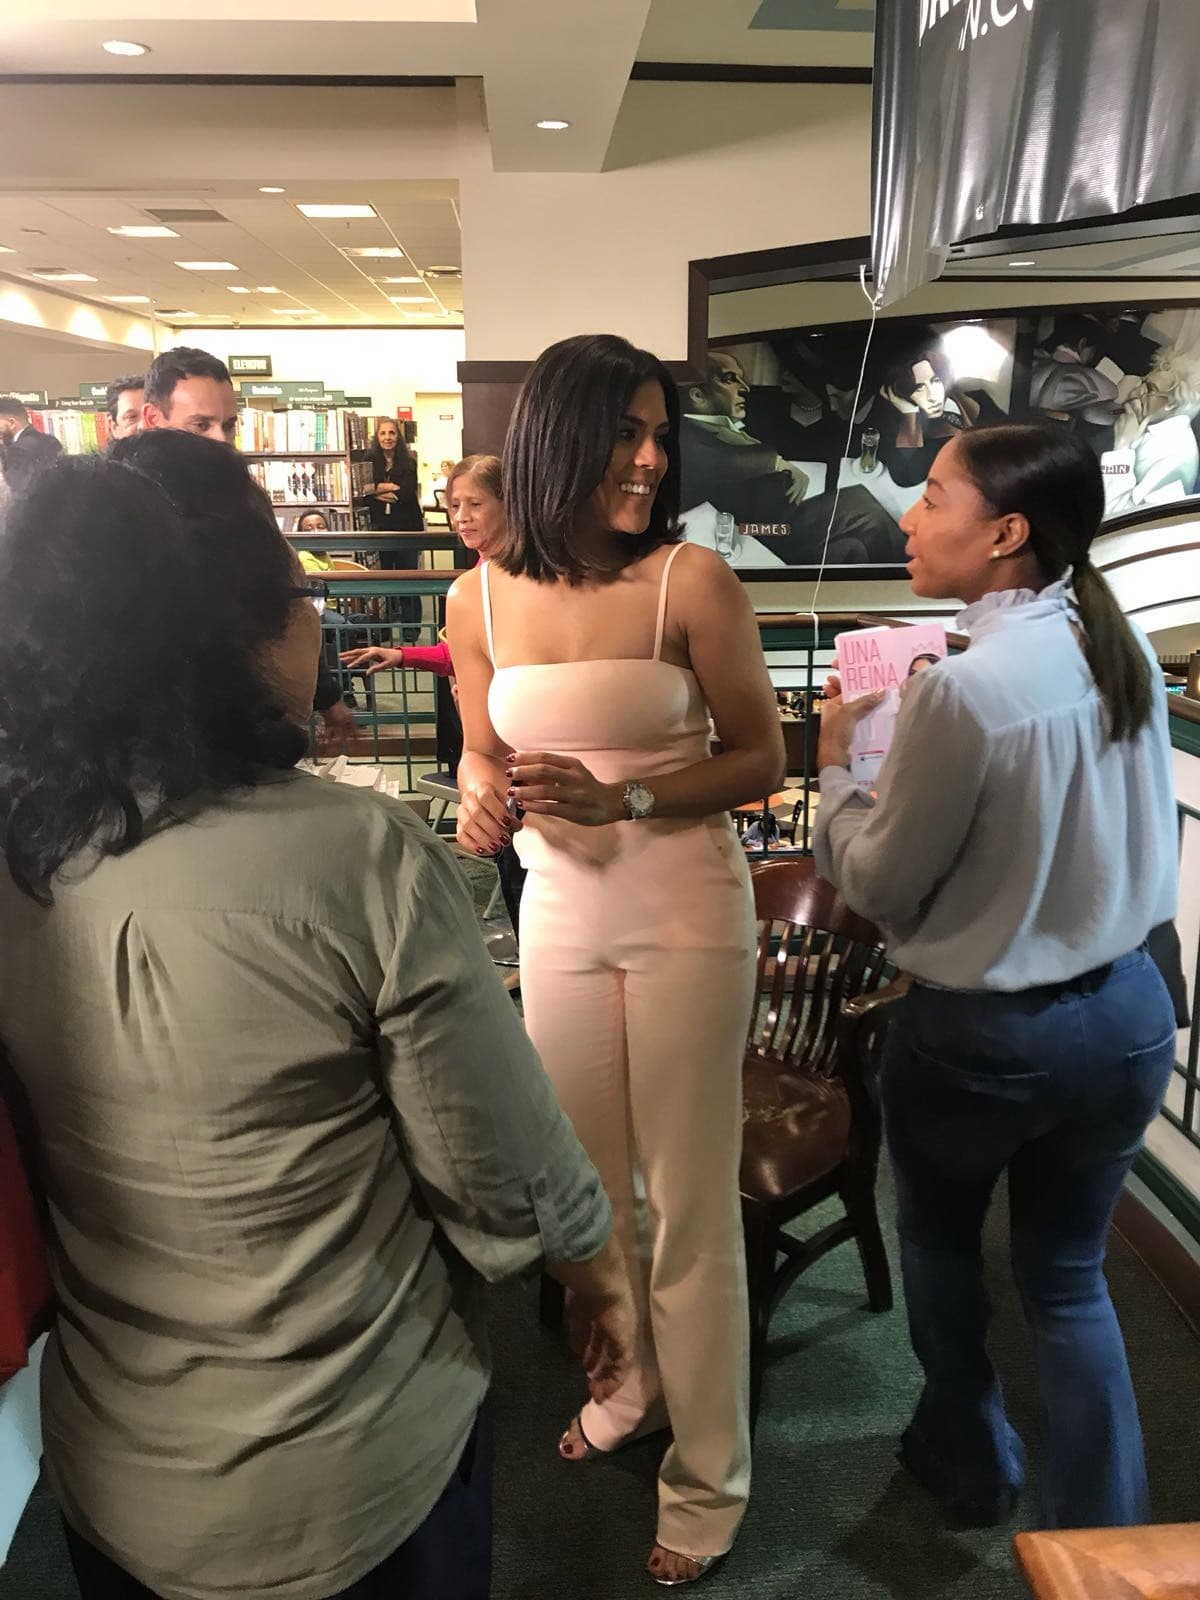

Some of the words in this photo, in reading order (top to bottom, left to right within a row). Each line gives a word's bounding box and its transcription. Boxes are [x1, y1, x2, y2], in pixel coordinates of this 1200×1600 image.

[743, 523, 787, 535] JAMES
[843, 638, 881, 666] UNA
[846, 663, 899, 692] REINA
